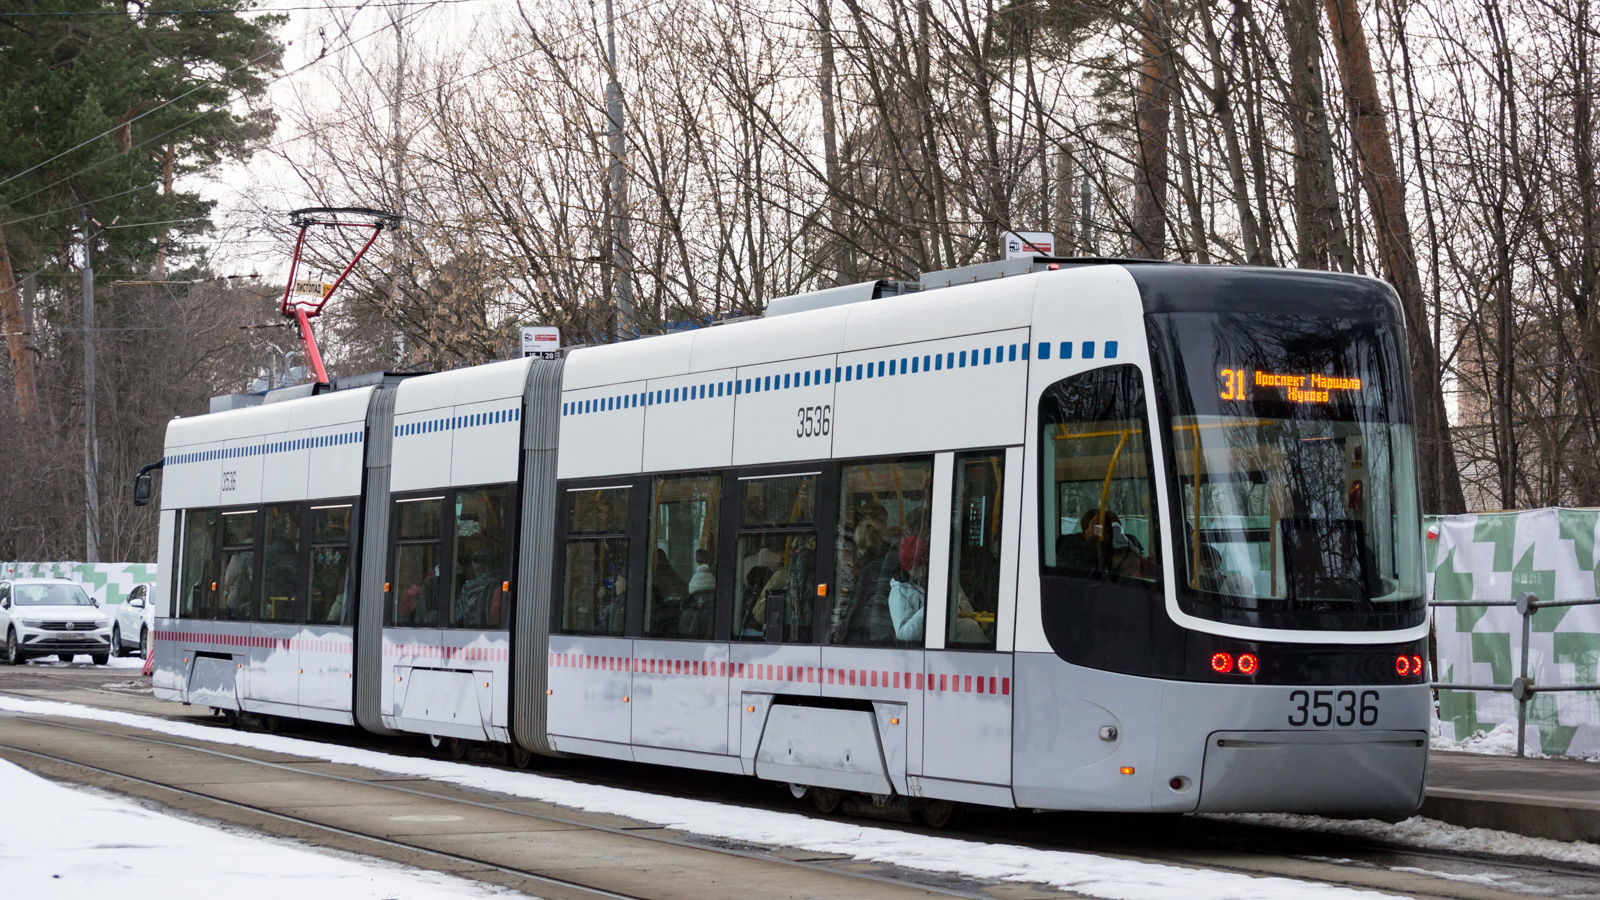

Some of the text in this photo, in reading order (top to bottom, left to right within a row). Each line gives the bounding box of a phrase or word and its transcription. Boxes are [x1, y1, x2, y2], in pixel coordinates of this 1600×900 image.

[545, 352, 554, 360] 28
[1221, 369, 1245, 400] 31
[1255, 371, 1361, 390] Проспект Маршала
[1288, 386, 1329, 403] Жукова
[796, 404, 831, 438] 3536
[222, 470, 236, 491] 3536
[1288, 690, 1380, 727] 3536
